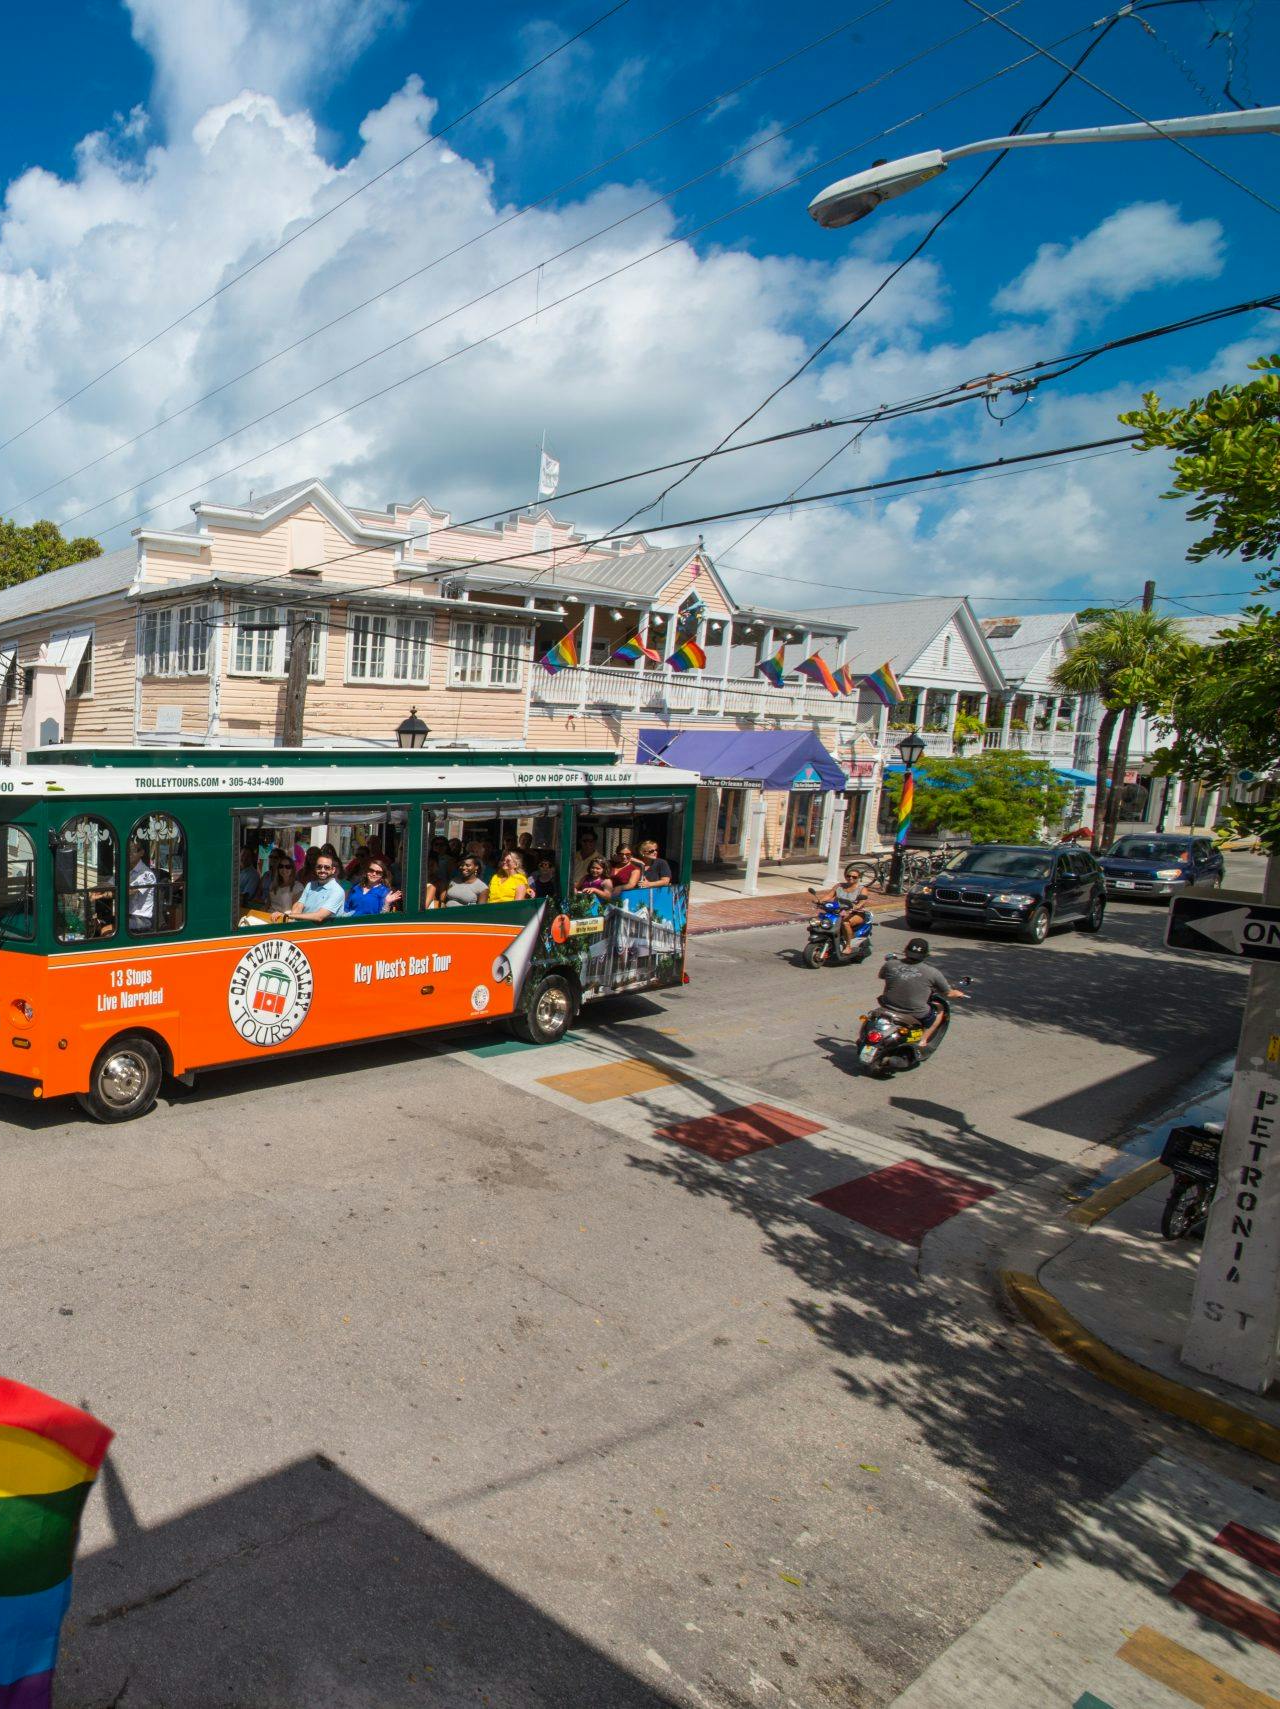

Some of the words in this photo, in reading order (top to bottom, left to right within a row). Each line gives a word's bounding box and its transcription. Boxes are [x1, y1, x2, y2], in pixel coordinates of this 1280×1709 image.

[135, 777, 219, 788] TROLLEYTOURS.COM
[228, 776, 284, 787] 305-434-4900
[518, 774, 534, 783] HOP
[536, 774, 546, 782] ON
[549, 774, 564, 782] HOP
[566, 774, 578, 782] OFF
[584, 773, 602, 782] TOUR
[605, 773, 617, 781] ALL
[619, 773, 632, 781] DAY
[111, 969, 123, 988] 13
[125, 968, 153, 987] Stops
[231, 965, 251, 996] OLD
[245, 941, 283, 968] TOWN
[284, 945, 313, 1012] TROLLEY
[354, 963, 373, 985] Key
[375, 957, 407, 981] West's
[408, 955, 429, 976] Best
[432, 953, 452, 973] Tour
[97, 993, 118, 1012] Live
[120, 987, 164, 1009] Narrated
[234, 1006, 293, 1045] TOURS
[1225, 1090, 1279, 1284] PETRONIA
[1203, 1300, 1255, 1332] ST
